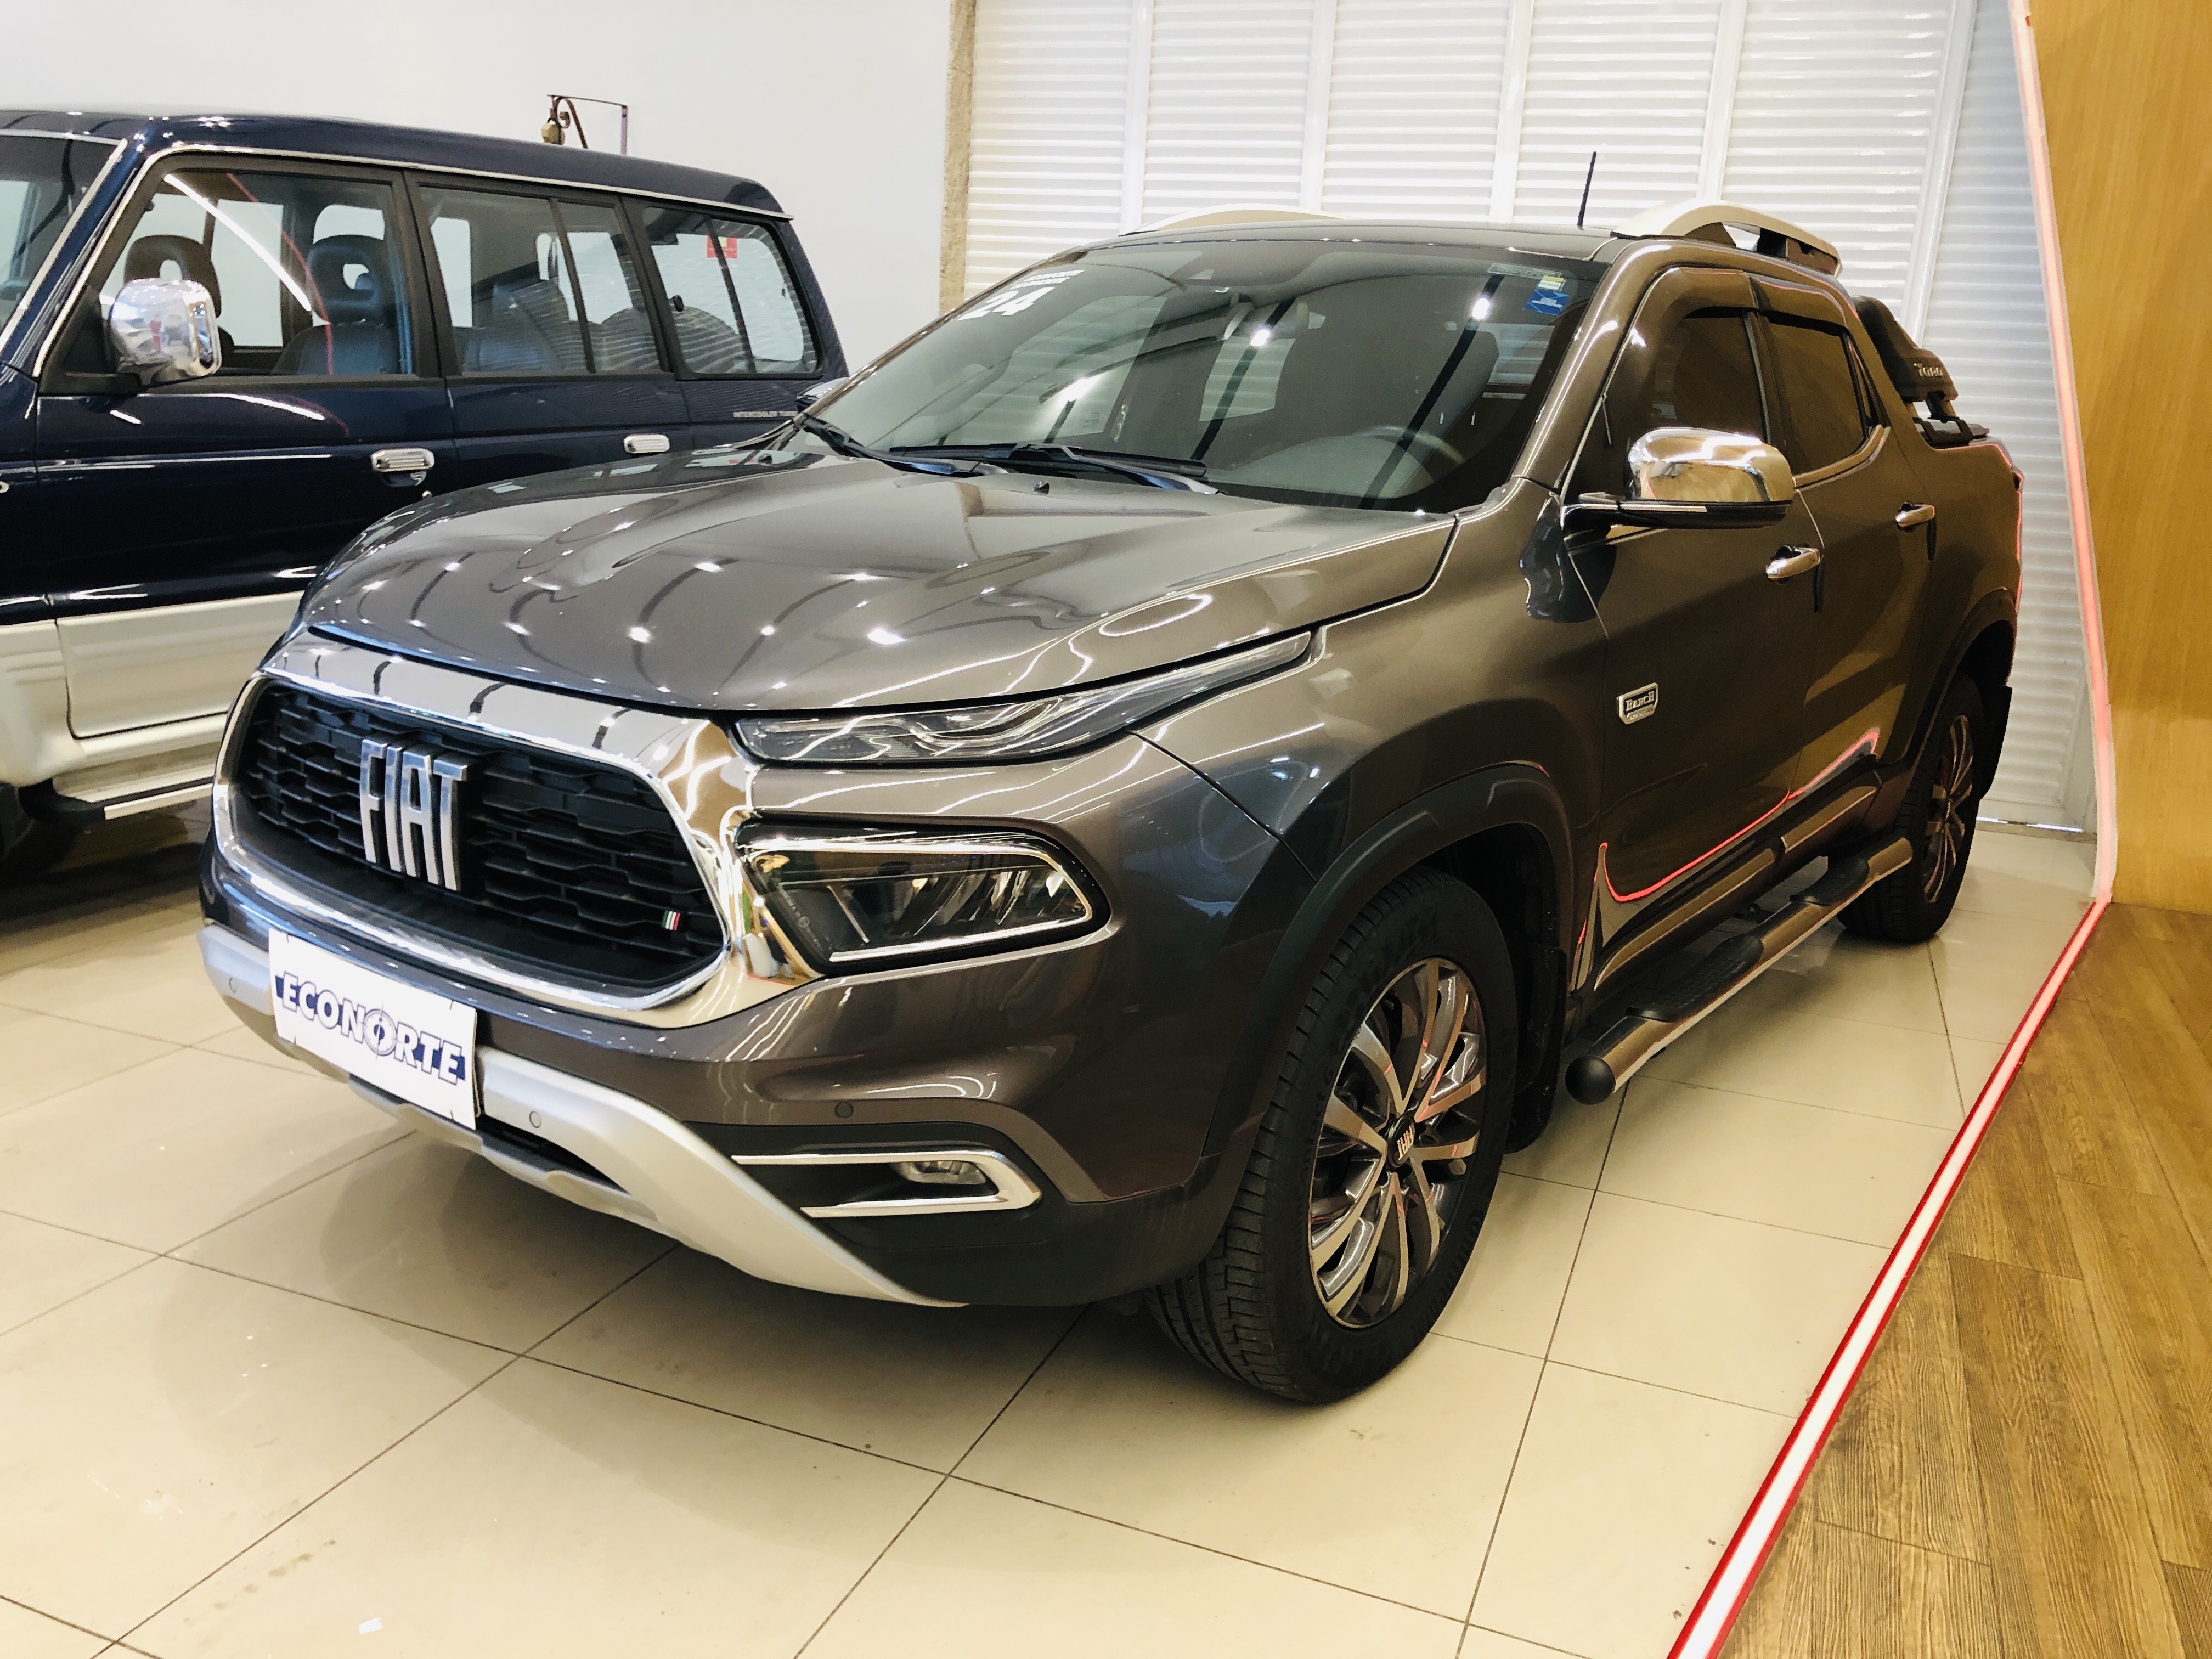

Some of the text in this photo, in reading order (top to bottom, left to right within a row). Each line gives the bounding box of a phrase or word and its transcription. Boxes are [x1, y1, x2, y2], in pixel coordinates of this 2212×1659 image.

[957, 286, 1055, 321] 24
[1626, 691, 1655, 712] RANCH
[359, 738, 468, 891] FIAT
[281, 971, 463, 1085] ECONORTE
[1397, 1125, 1414, 1161] FIAT
